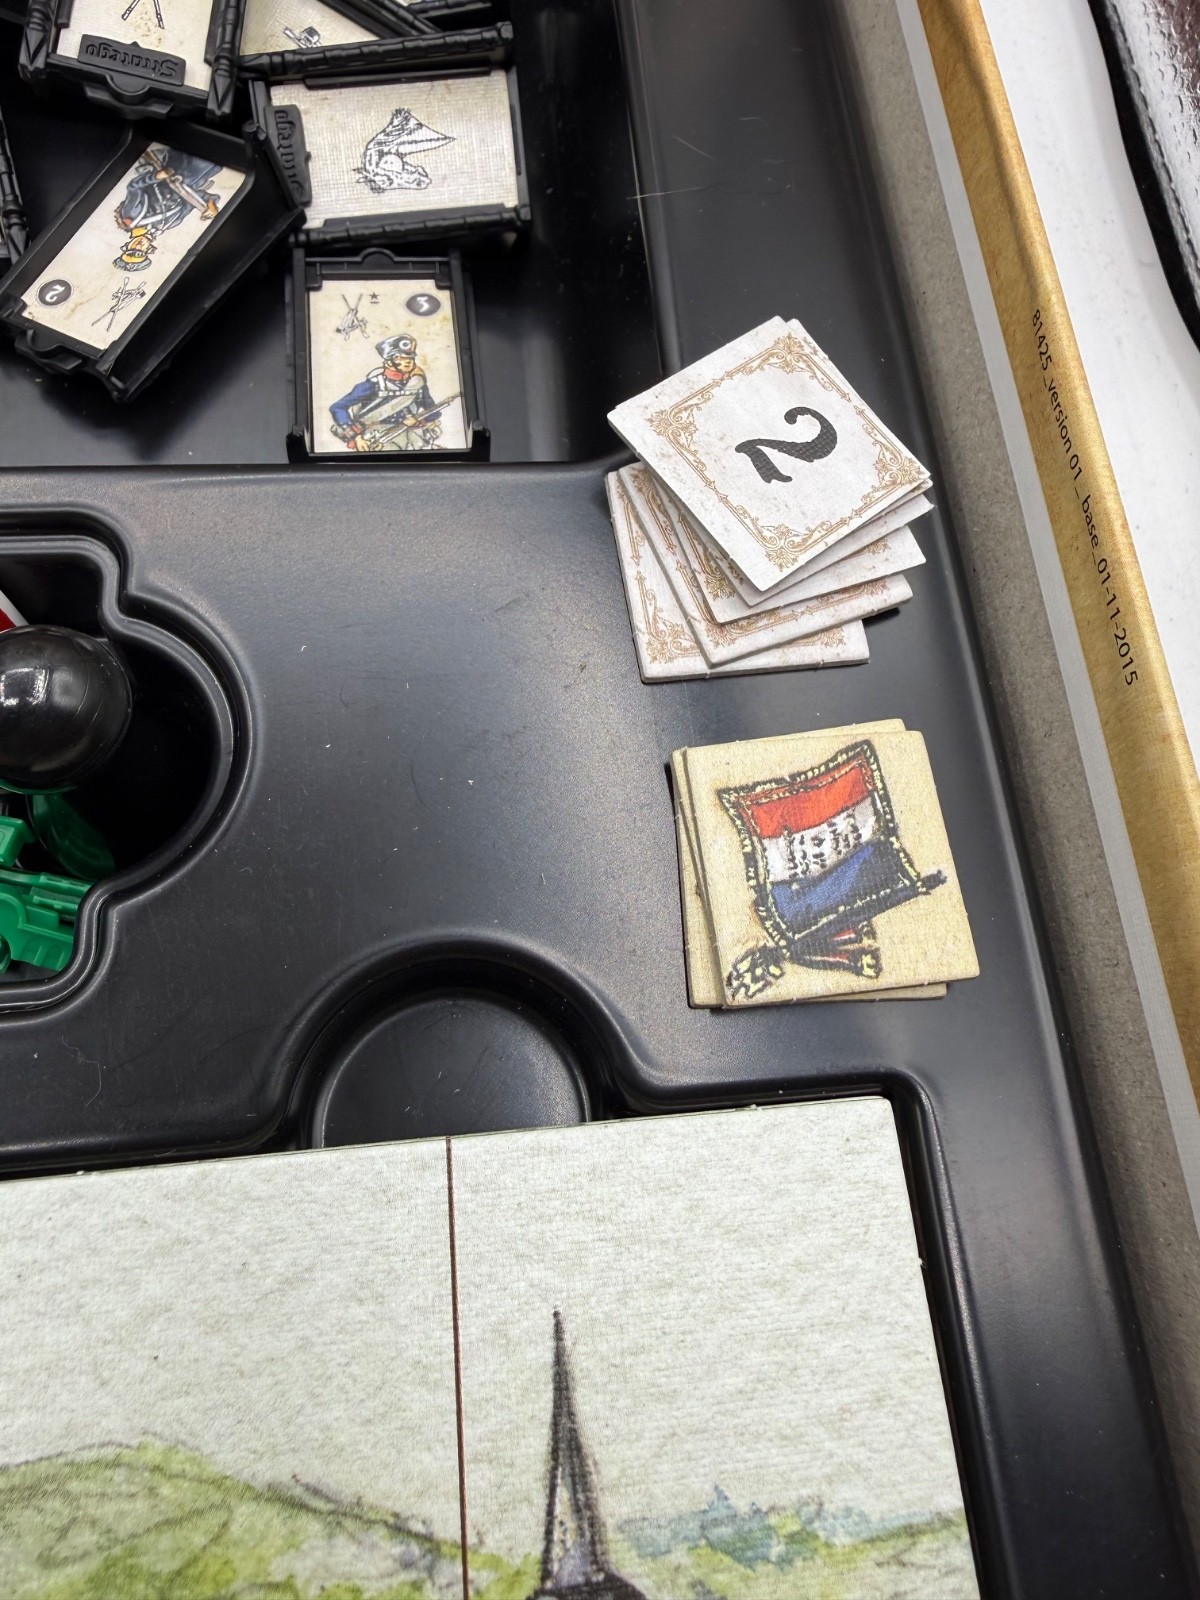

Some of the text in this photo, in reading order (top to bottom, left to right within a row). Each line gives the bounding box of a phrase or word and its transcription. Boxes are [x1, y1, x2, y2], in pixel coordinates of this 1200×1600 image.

[85, 42, 180, 77] Stratego
[45, 284, 66, 302] 2
[416, 296, 430, 313] 3
[734, 406, 838, 484] 2
